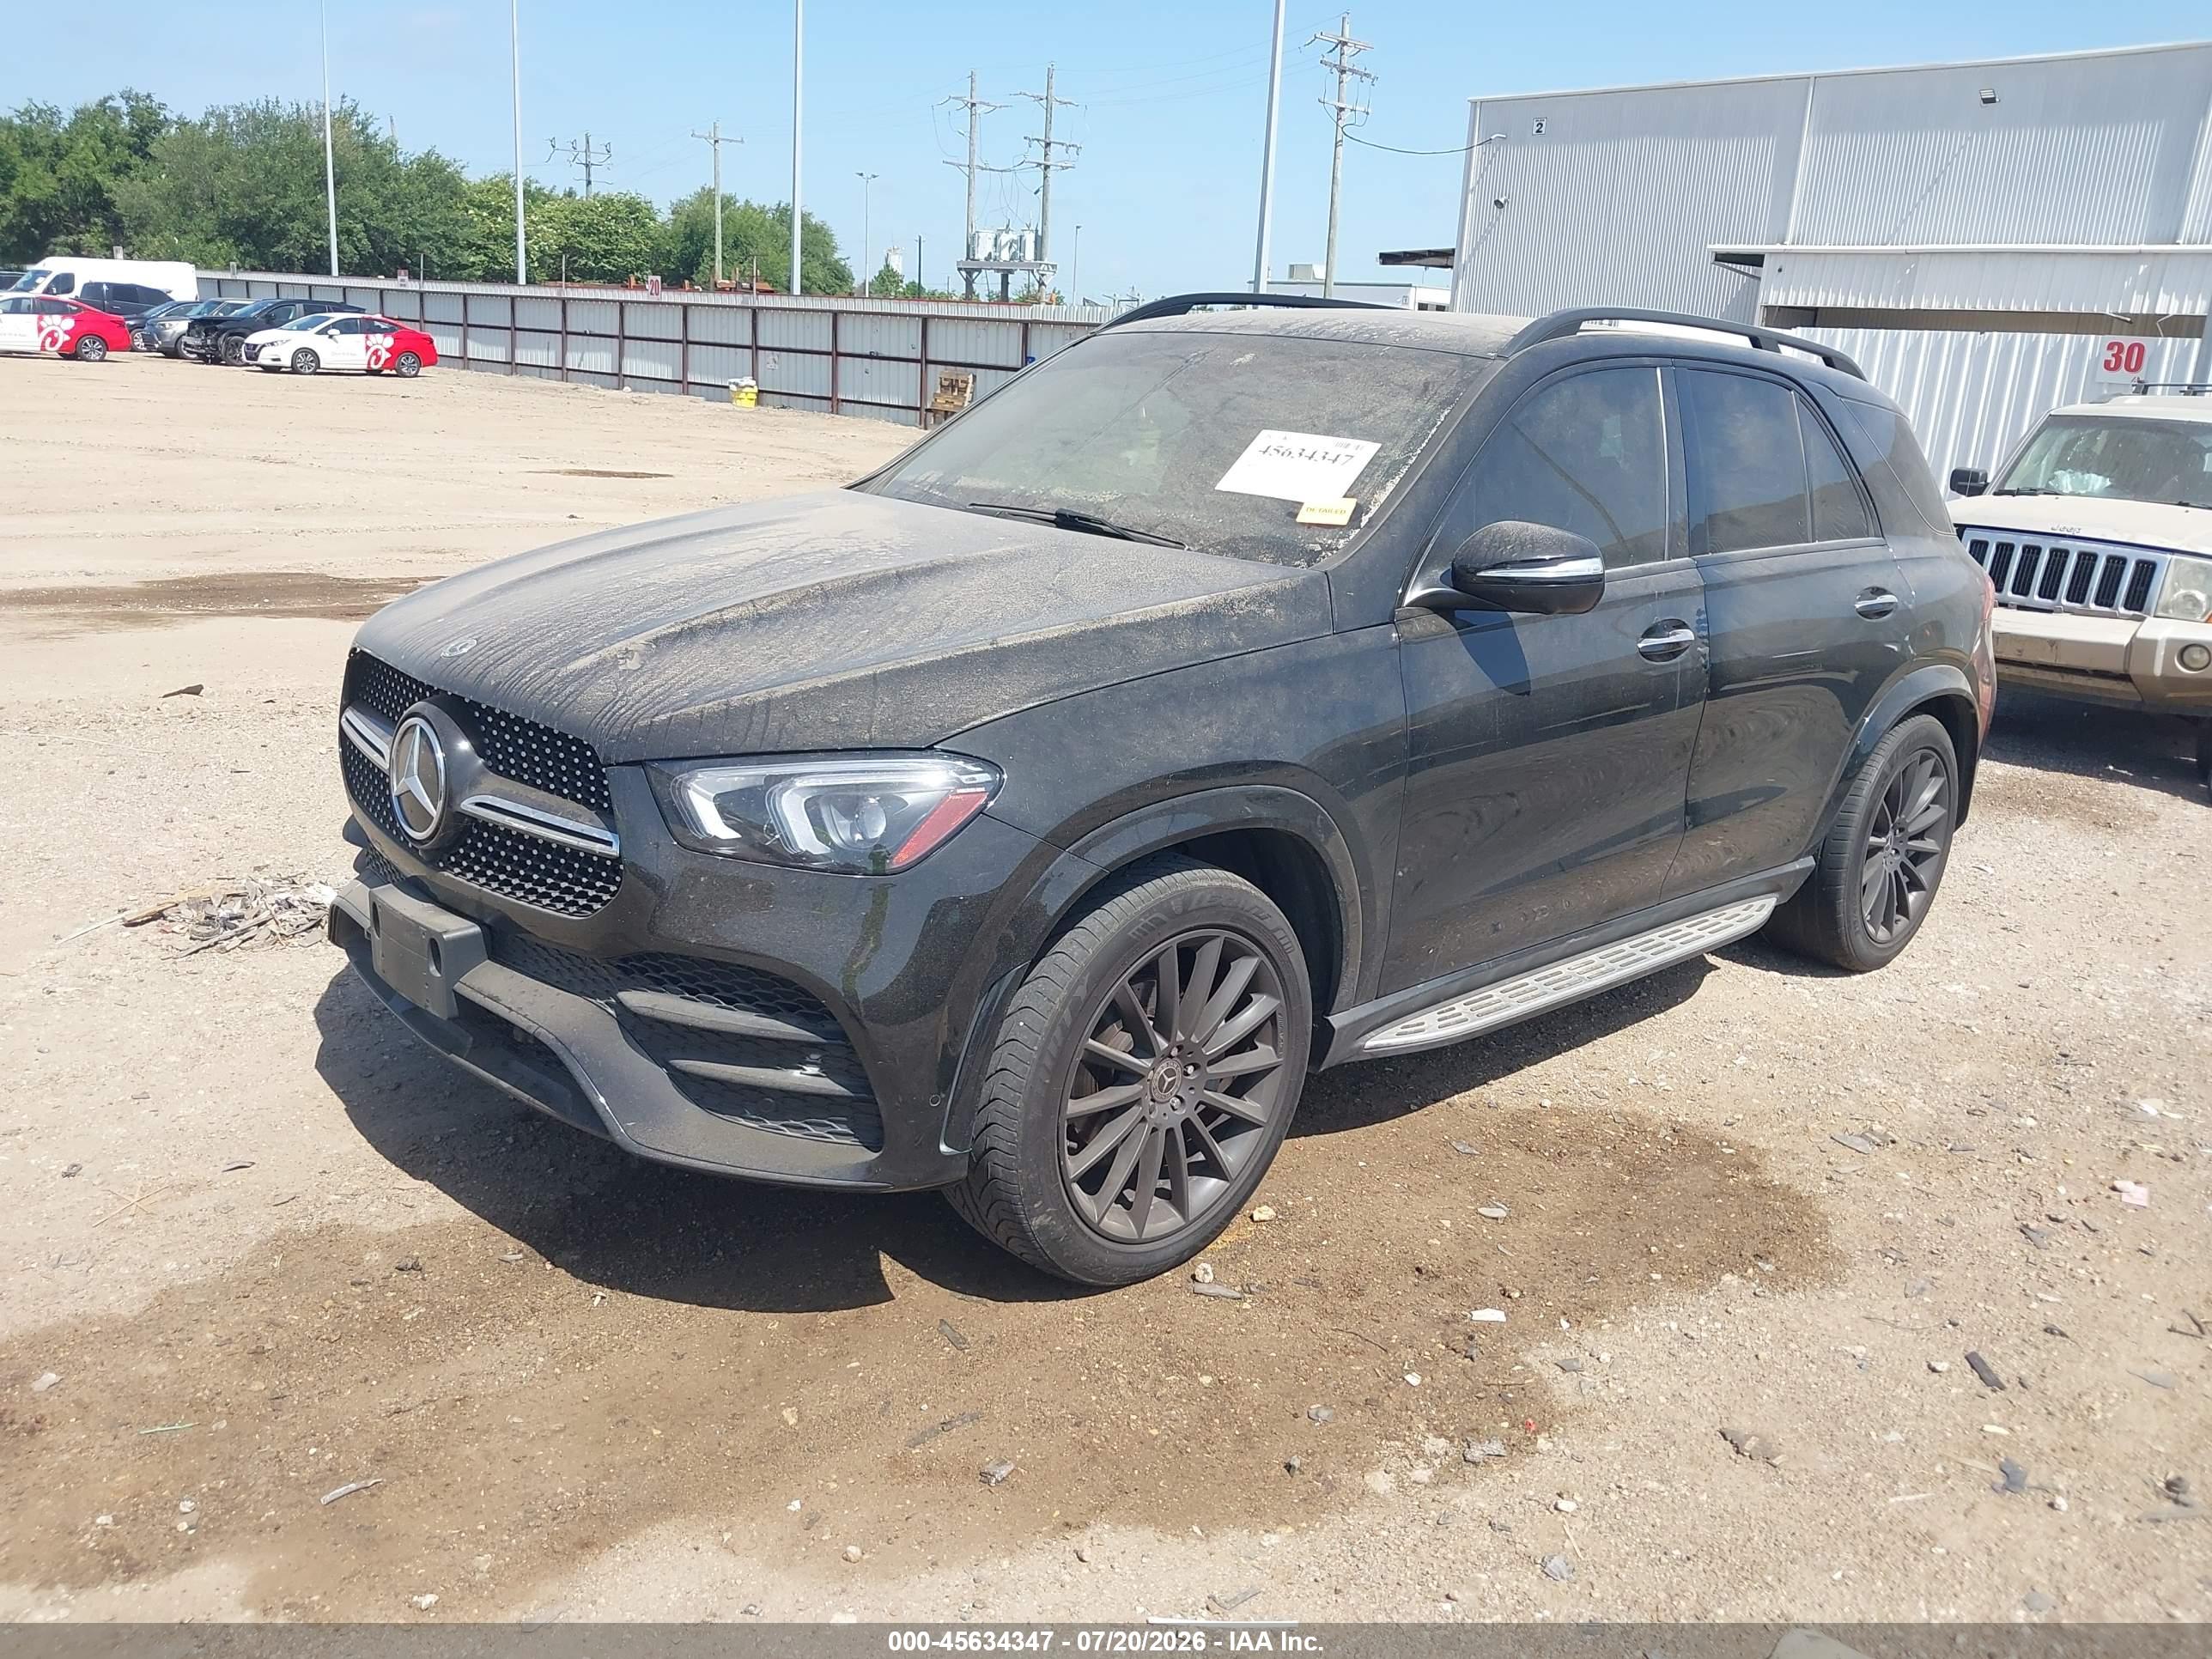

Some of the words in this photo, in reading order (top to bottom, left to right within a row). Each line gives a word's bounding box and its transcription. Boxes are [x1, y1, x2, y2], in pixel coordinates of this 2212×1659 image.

[1535, 123, 1544, 133] 2
[2104, 341, 2145, 373] 30
[1258, 444, 1355, 466] 45634347
